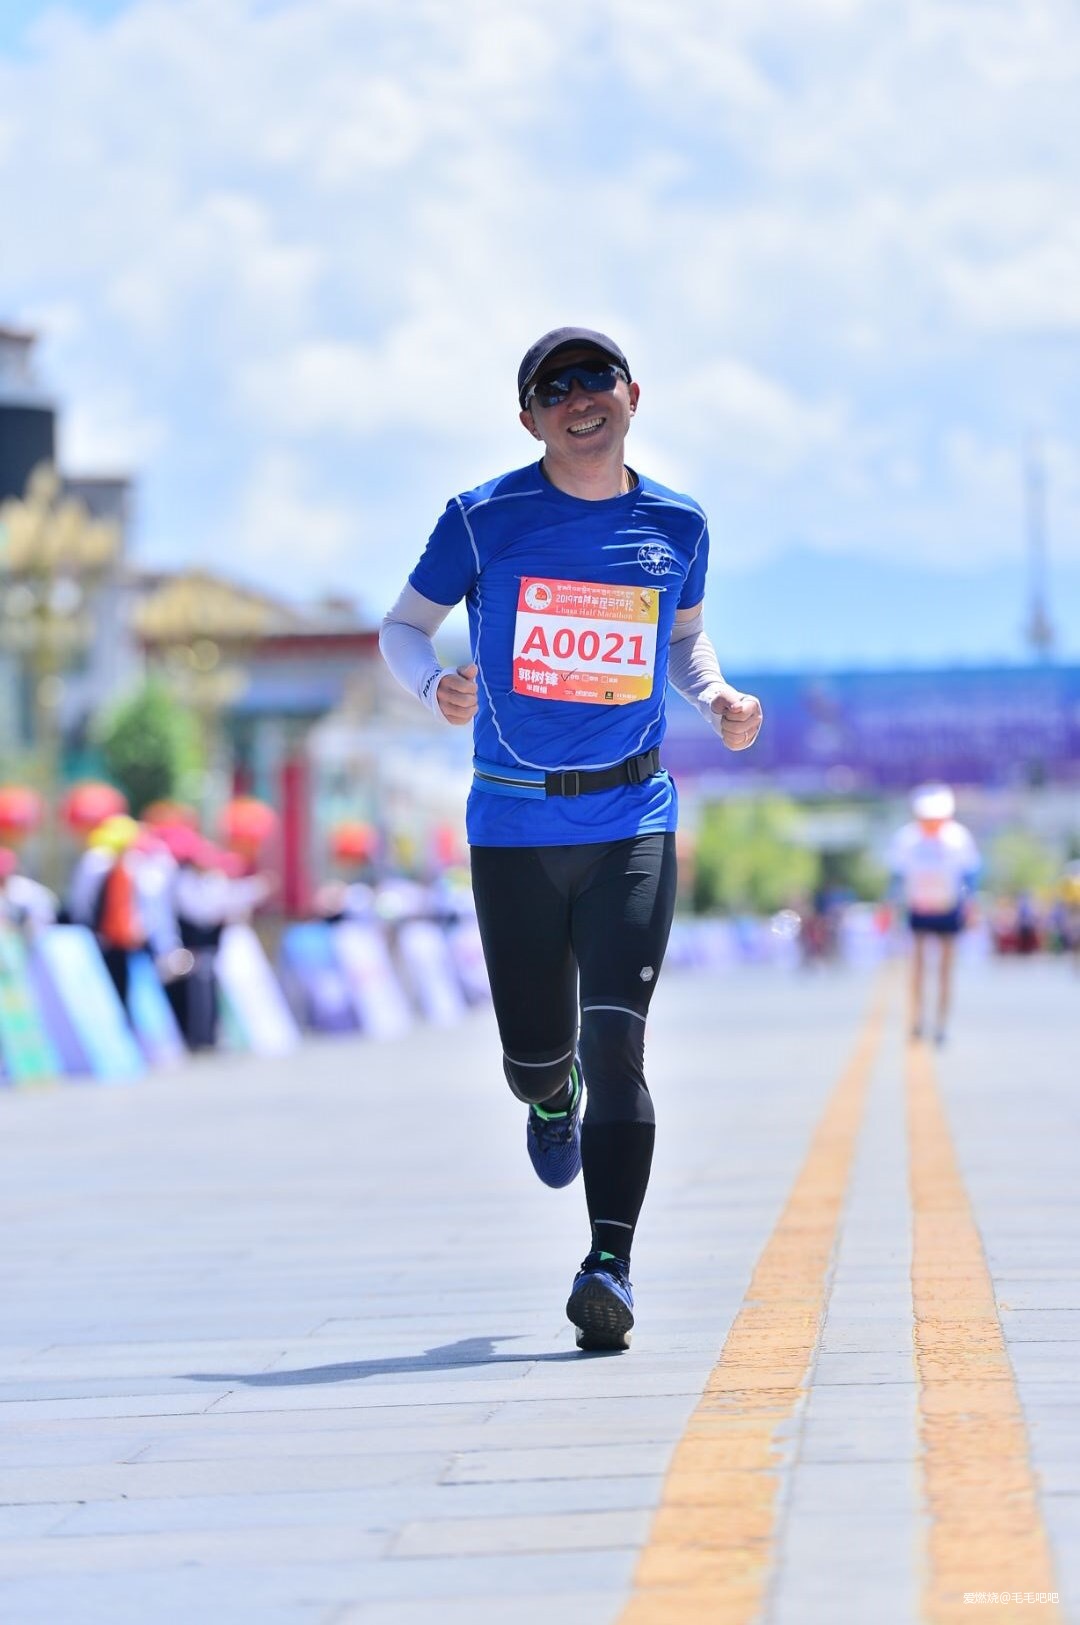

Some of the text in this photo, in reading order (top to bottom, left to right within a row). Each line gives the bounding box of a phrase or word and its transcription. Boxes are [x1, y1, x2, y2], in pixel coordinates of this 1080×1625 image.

[580, 608, 594, 616] Half
[597, 610, 633, 620] Marathon
[521, 626, 647, 666] A0021
